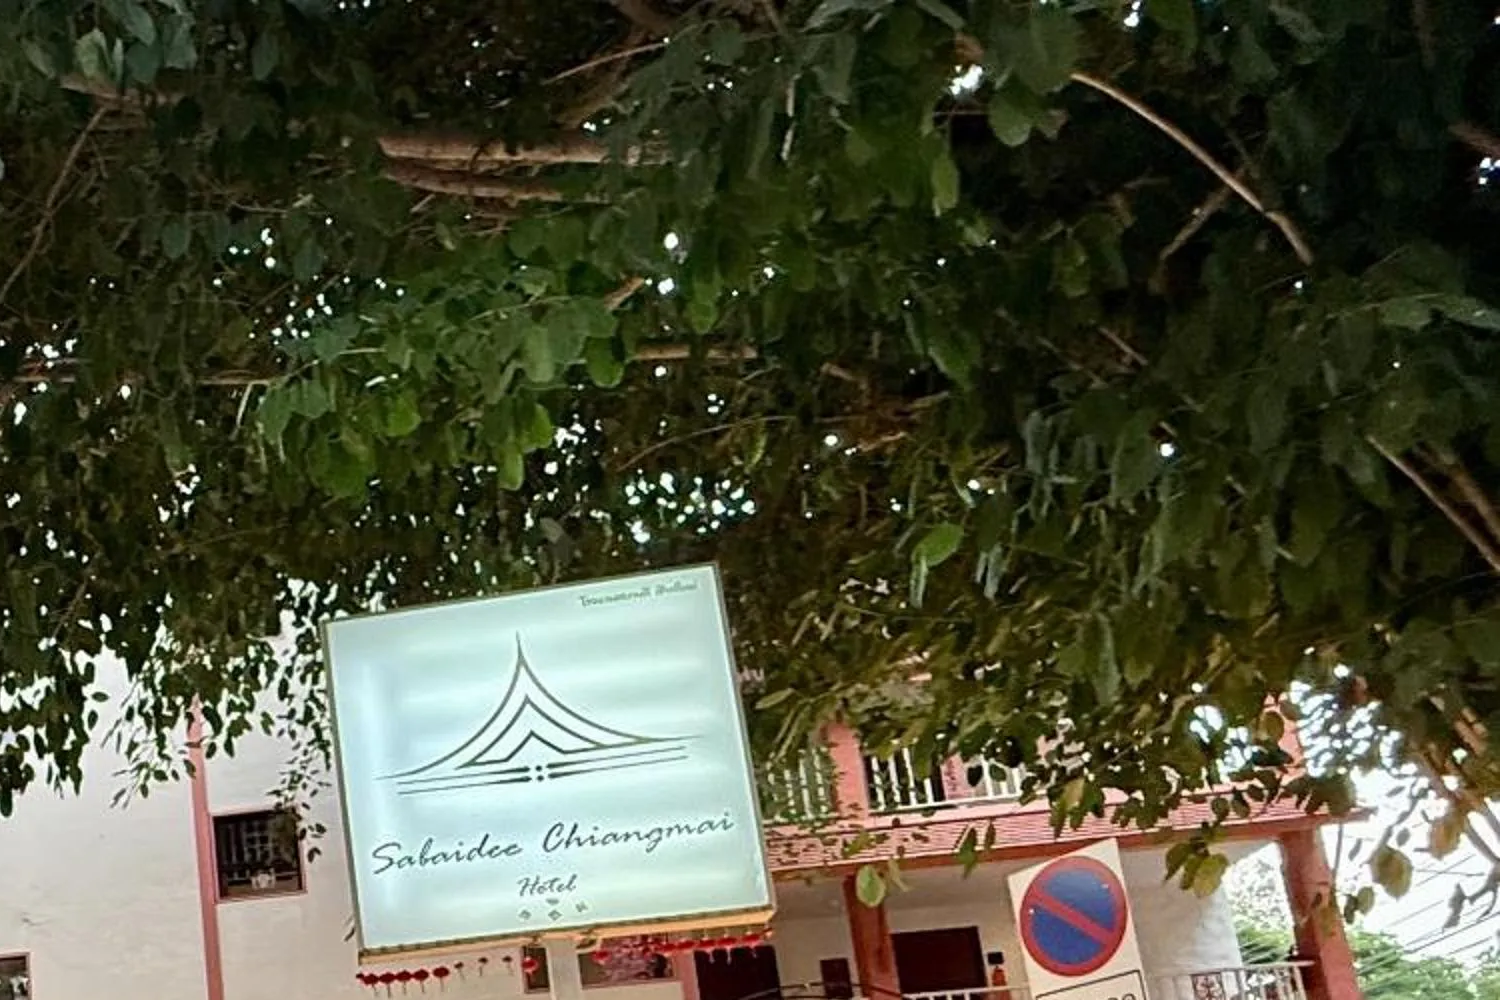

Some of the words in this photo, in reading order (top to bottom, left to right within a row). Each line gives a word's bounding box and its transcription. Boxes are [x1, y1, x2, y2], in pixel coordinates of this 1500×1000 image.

[371, 833, 523, 875] Sabaidee
[542, 811, 735, 853] Chiangmai
[517, 873, 578, 896] Hotel
